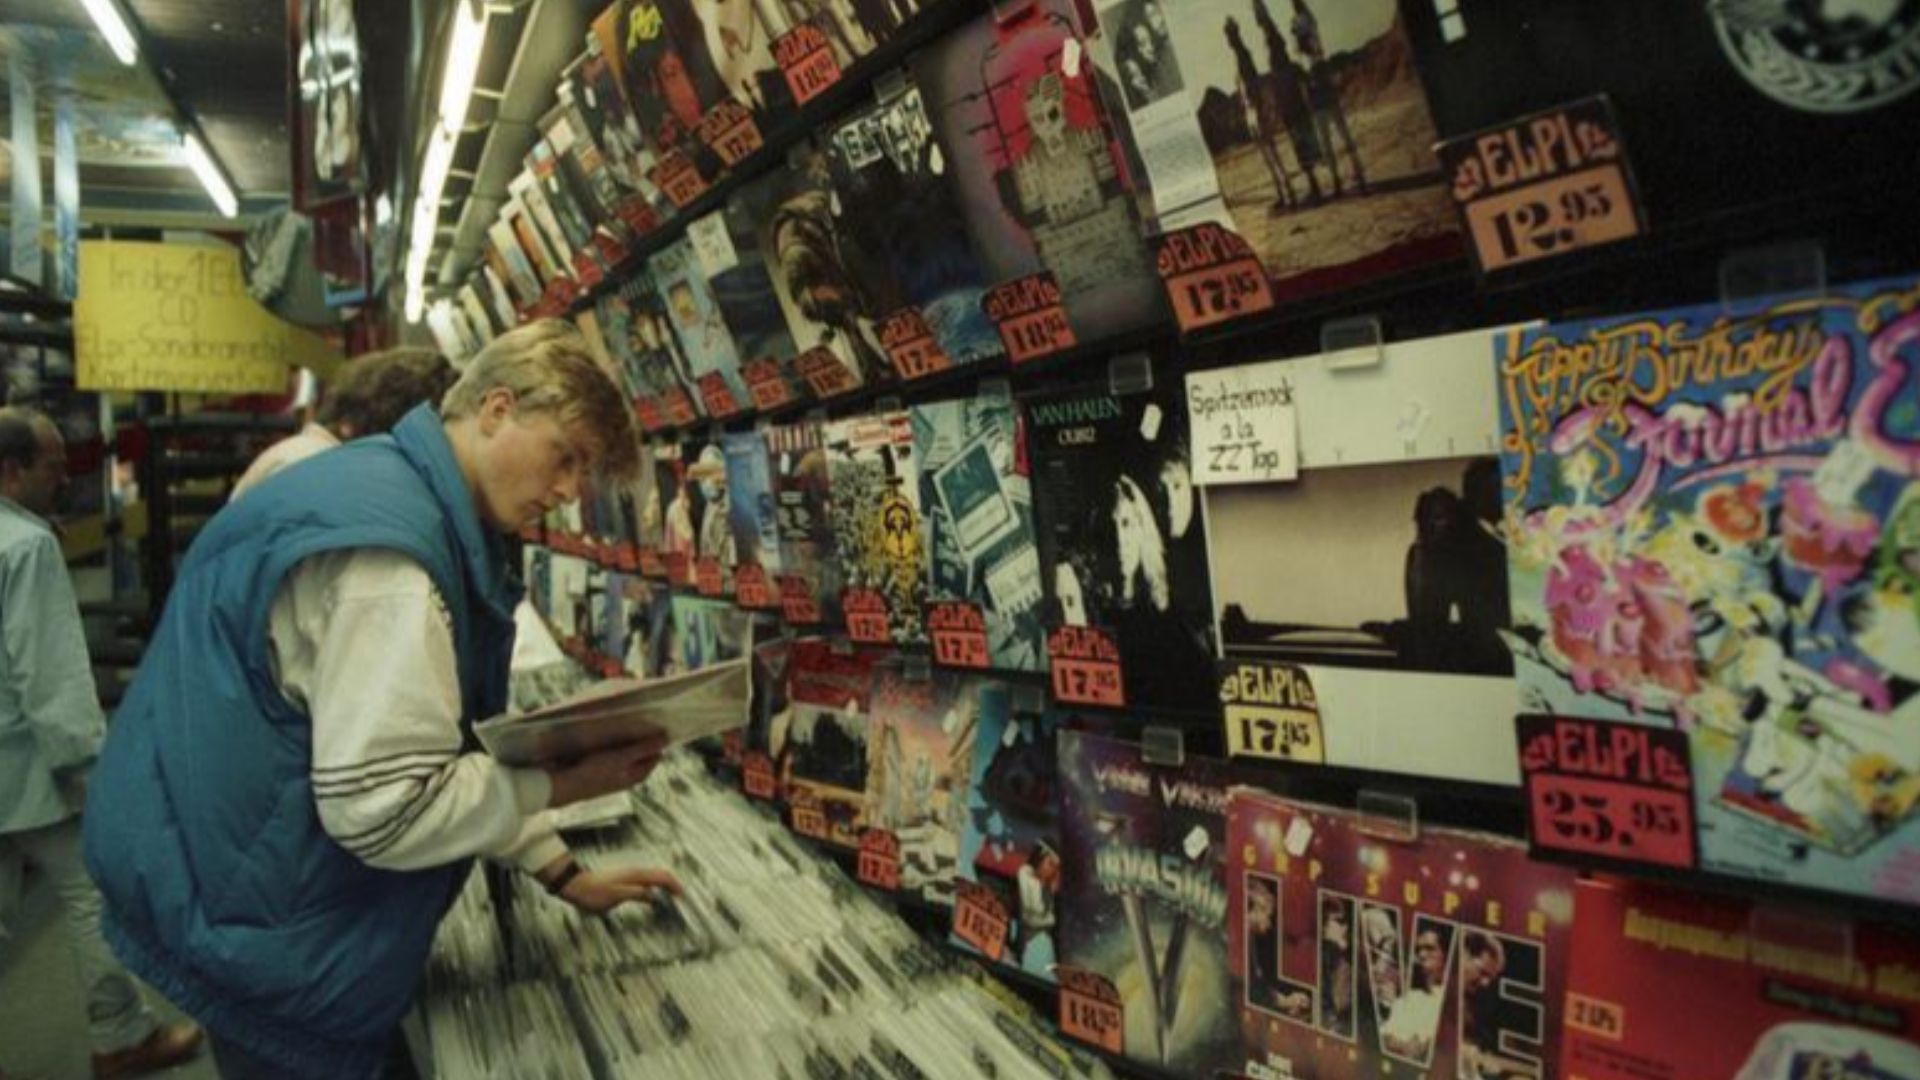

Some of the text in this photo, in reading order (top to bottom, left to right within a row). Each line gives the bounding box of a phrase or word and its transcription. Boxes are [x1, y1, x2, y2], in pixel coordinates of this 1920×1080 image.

[1478, 113, 1582, 188] ELPI
[1494, 183, 1612, 260] 12.95
[1186, 270, 1259, 317] 17.95
[1603, 315, 1823, 413] Birthday
[1030, 396, 1121, 425] VAN HALEN
[1208, 440, 1279, 480] ZZ Top
[1060, 667, 1118, 699] 17.95
[1239, 665, 1296, 707] ELPI
[1240, 718, 1311, 756] 17.95
[1555, 721, 1653, 783] ELPI
[1542, 789, 1682, 848] 25.95
[1364, 871, 1546, 938] SUPER
[1242, 869, 1545, 1080] LIVE
